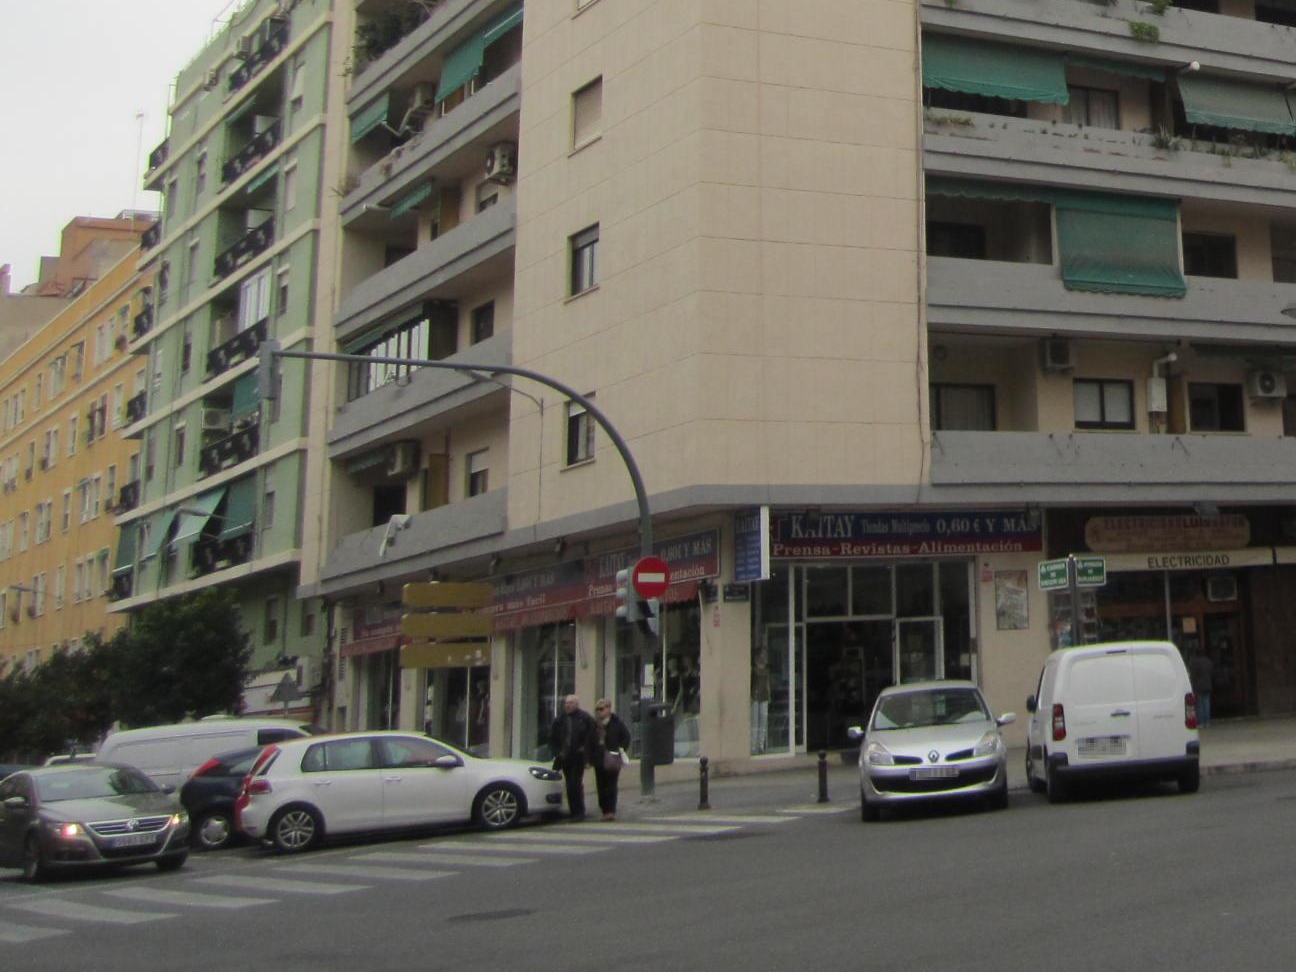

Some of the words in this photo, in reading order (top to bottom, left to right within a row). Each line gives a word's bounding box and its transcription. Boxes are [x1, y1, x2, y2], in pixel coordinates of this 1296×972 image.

[985, 517, 995, 533] Y
[1147, 554, 1230, 569] ELECTRICIDAD
[670, 564, 705, 580] entación
